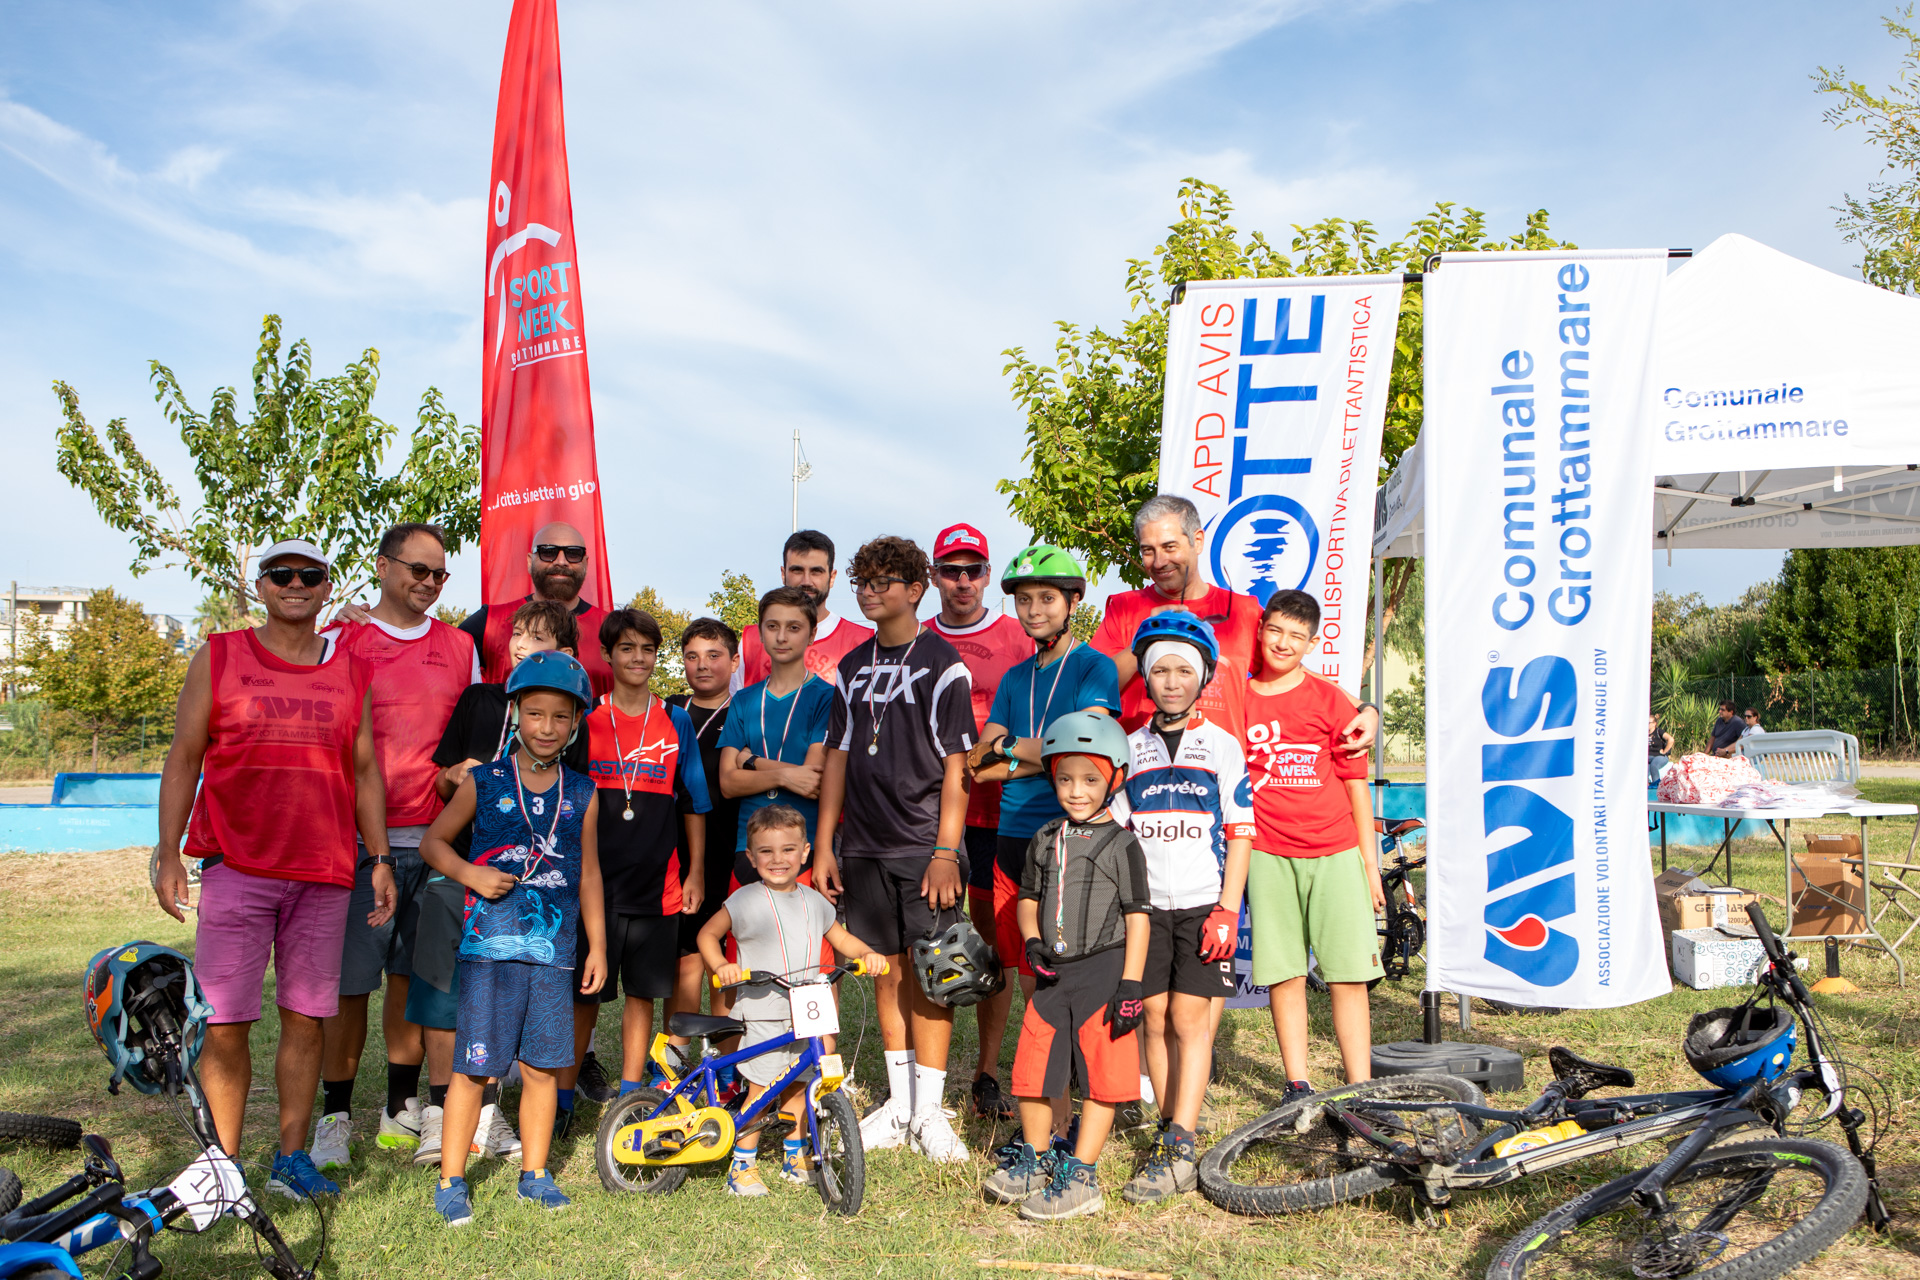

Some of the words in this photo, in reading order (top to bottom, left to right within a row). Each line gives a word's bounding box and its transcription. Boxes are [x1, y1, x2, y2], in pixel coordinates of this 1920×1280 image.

[1197, 303, 1235, 396] AVIS
[1192, 412, 1226, 498] APD
[1547, 263, 1592, 626] Grottammare
[1323, 487, 1350, 656] POLISPORTIVA
[1340, 295, 1373, 490] DILETTANTISTICA
[1491, 349, 1536, 631] Comunale
[500, 489, 522, 507] città
[568, 479, 596, 501] gio
[1594, 648, 1608, 677] ODV
[848, 665, 931, 704] FOX
[1201, 686, 1223, 699] EEK
[246, 696, 335, 723] AVIS
[1594, 679, 1608, 737] SANGUE
[588, 760, 667, 779] ASTARS
[1276, 752, 1319, 765] SPORT
[1278, 765, 1317, 777] WEEK
[1594, 741, 1608, 800] ITALIANI
[532, 796, 545, 816] 3
[1481, 655, 1580, 987] AVIS
[1141, 820, 1202, 842] bigla
[1594, 804, 1610, 883] VOLONTARI
[1597, 886, 1611, 986] ASSOCIAZIONE
[1220, 962, 1234, 988] FO
[806, 1000, 821, 1020] 8
